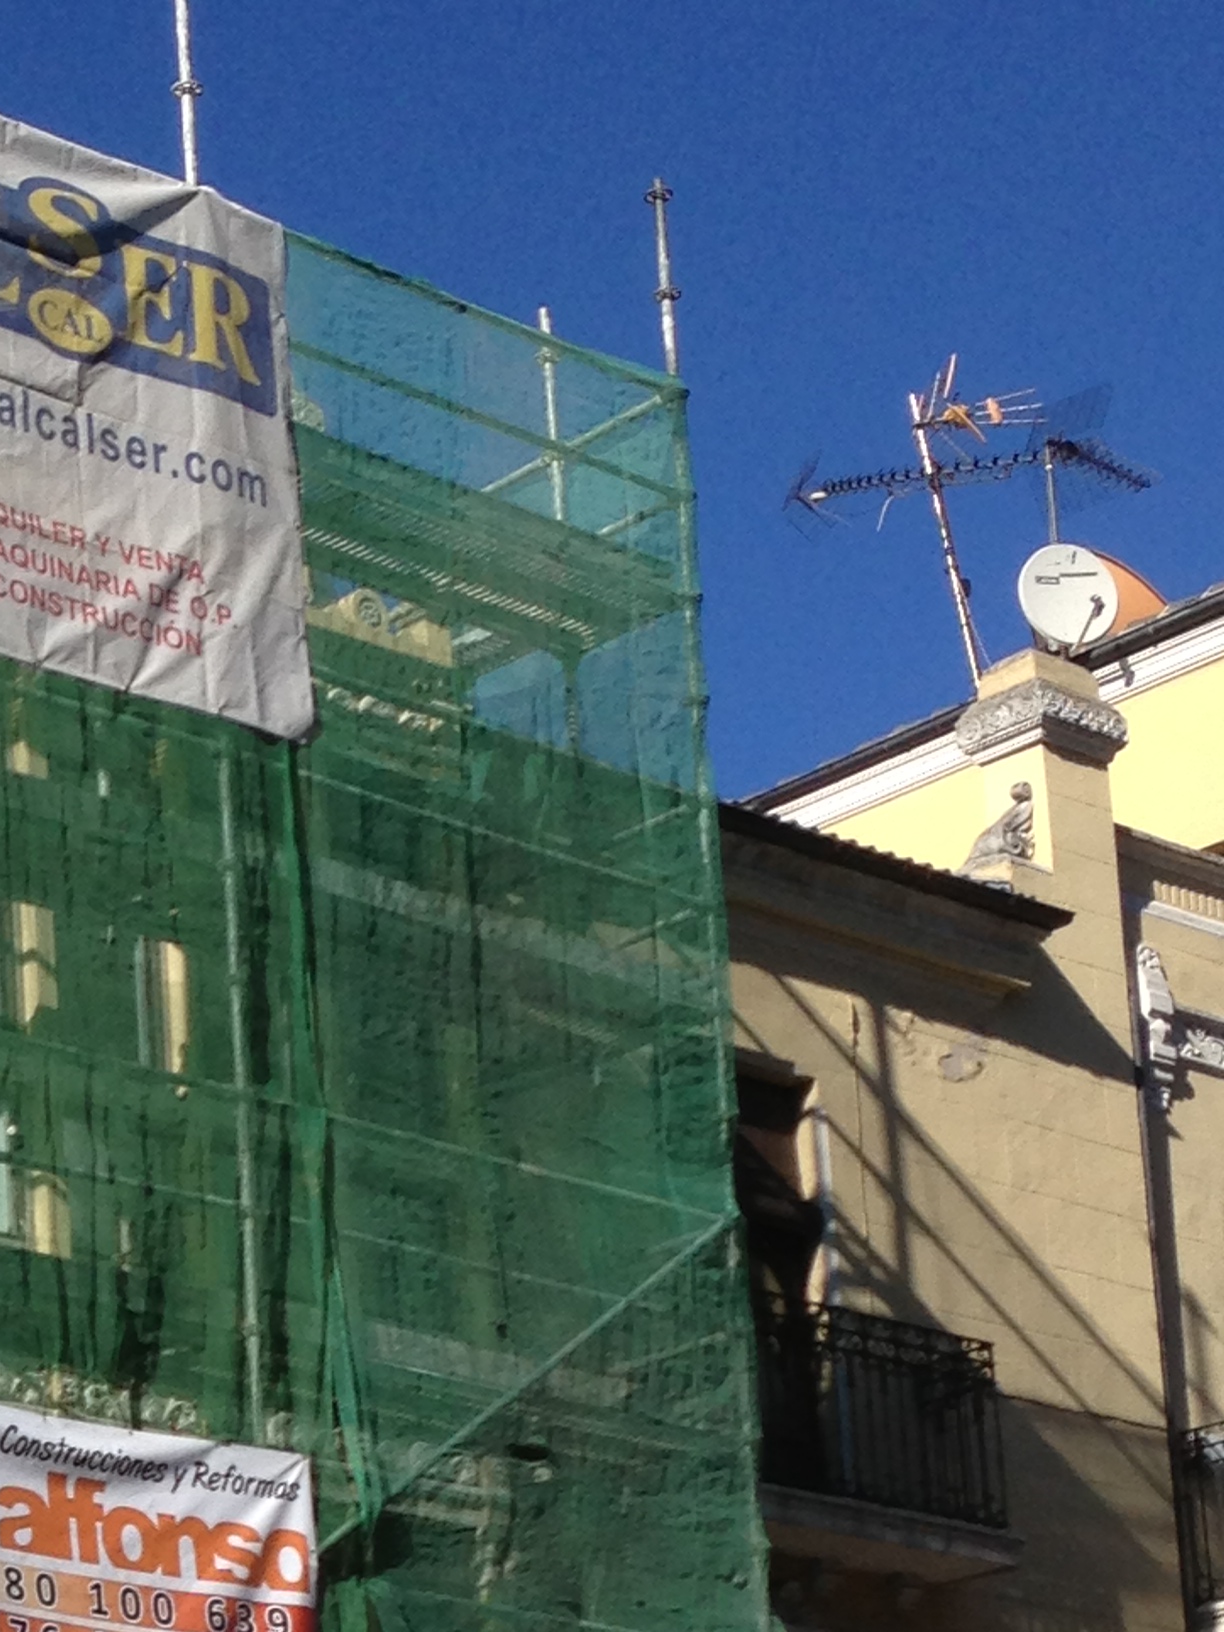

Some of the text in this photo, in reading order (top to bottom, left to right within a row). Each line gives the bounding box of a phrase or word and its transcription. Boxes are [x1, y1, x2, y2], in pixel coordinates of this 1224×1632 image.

[38, 300, 105, 343] CAL
[95, 535, 111, 558] Y
[119, 540, 205, 585] VENTA
[149, 582, 180, 614] DE
[0, 1424, 302, 1503] Construcciones y Reformas
[88, 1581, 175, 1626] 100
